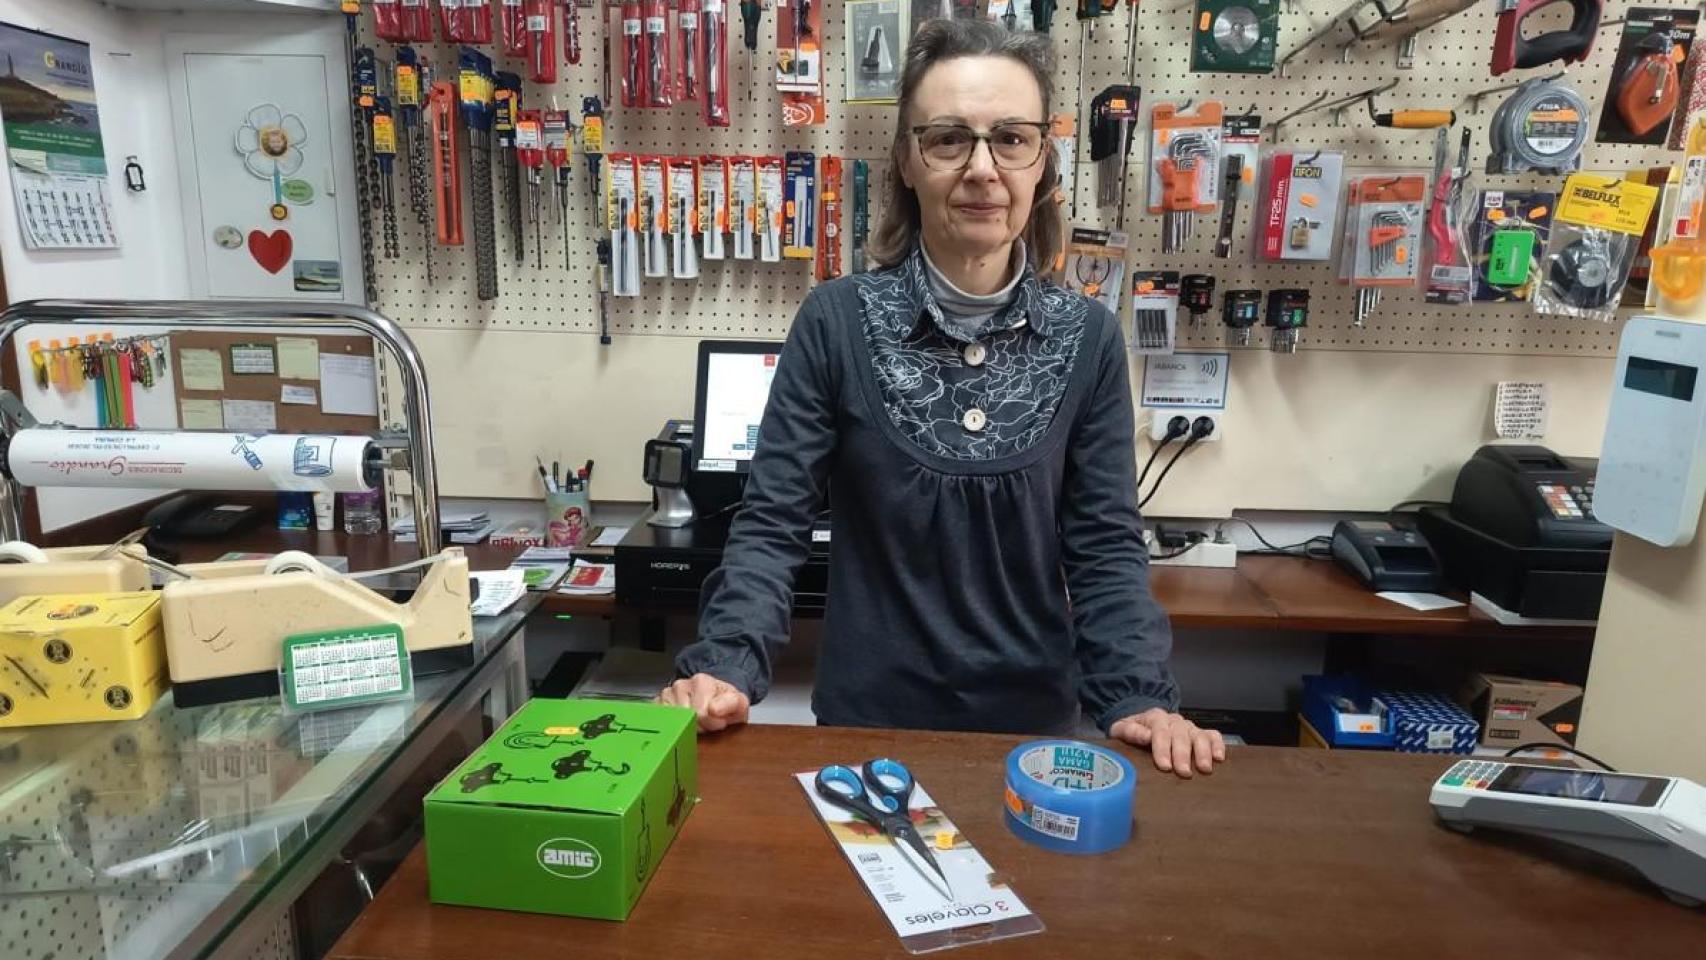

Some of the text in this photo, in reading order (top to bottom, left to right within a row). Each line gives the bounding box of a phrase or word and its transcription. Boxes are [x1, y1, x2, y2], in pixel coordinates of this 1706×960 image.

[1582, 188, 1622, 207] BELFLEX
[1058, 757, 1090, 768] GAMA
[904, 901, 1009, 925] 3 Claveles
